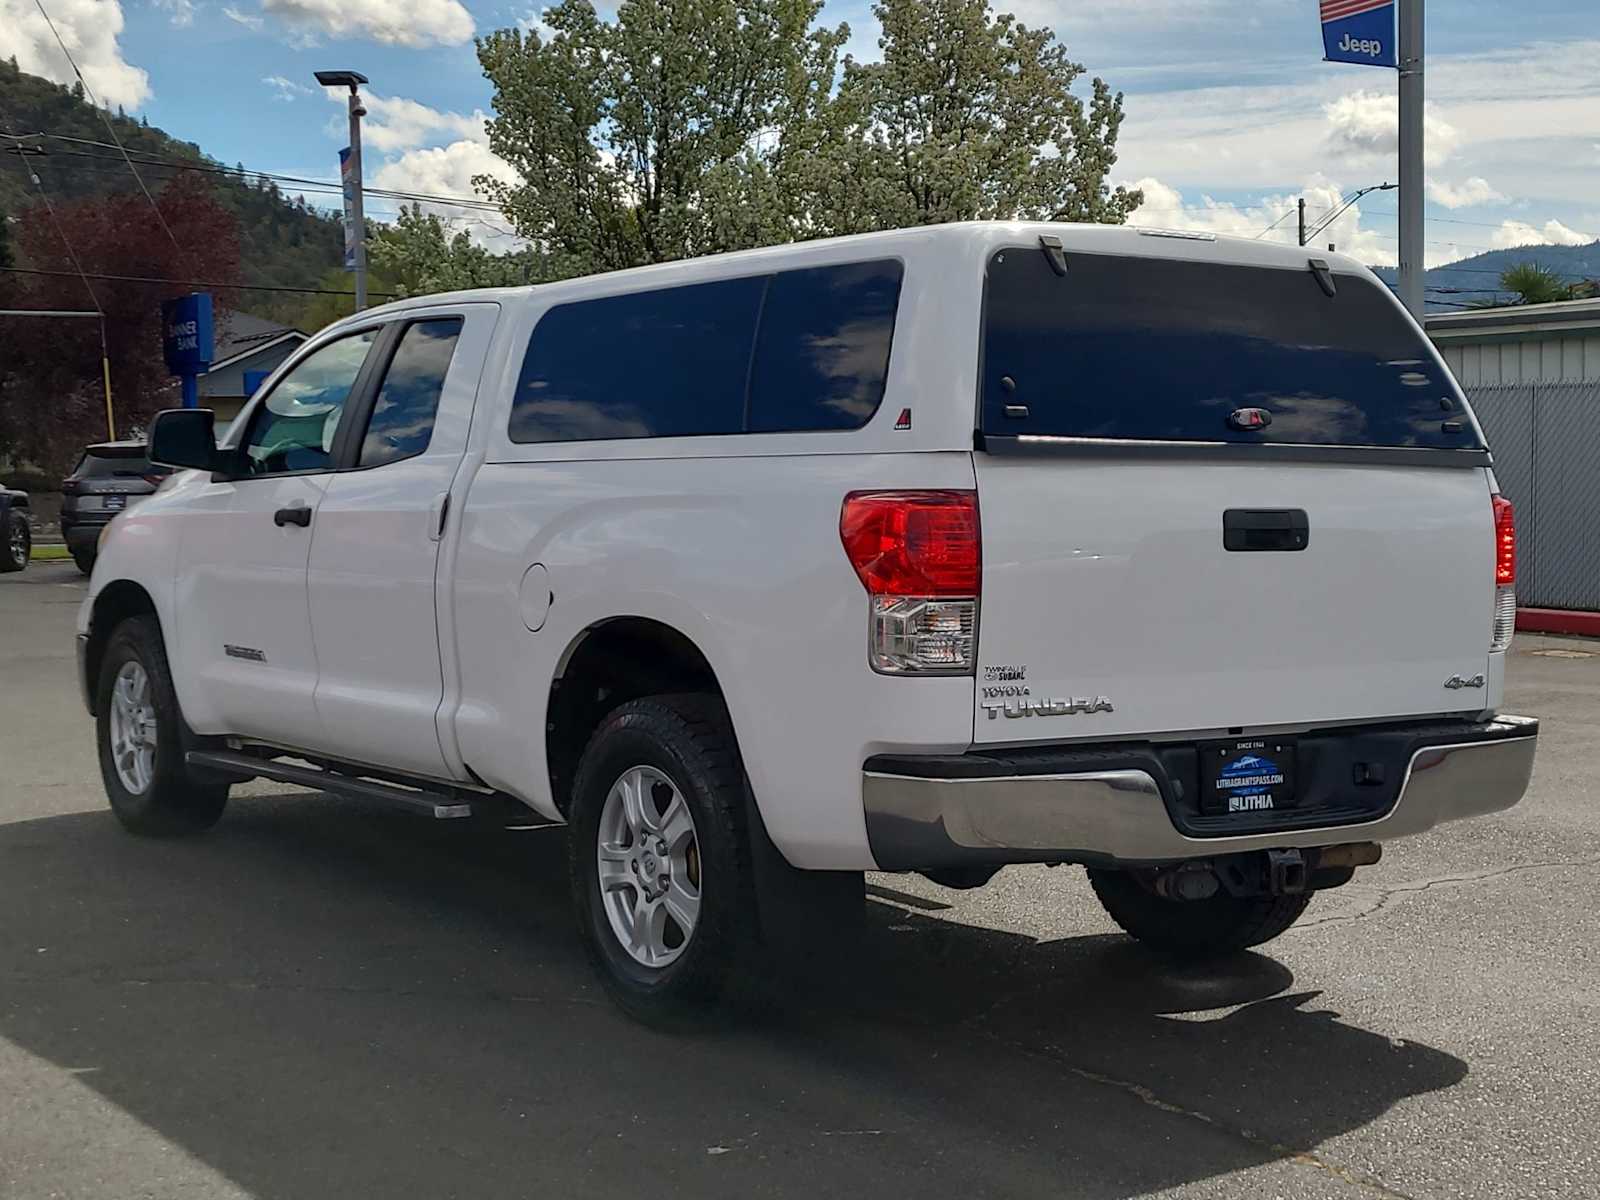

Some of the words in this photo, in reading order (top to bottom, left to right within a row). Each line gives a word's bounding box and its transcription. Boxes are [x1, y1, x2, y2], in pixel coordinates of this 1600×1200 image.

[1338, 33, 1382, 57] Jeep
[983, 686, 1030, 698] TOYOTA
[980, 697, 1113, 719] TUNDRA
[1216, 775, 1283, 789] LITHIAGRANTSPASS.COM
[1239, 794, 1274, 811] LITHIA
